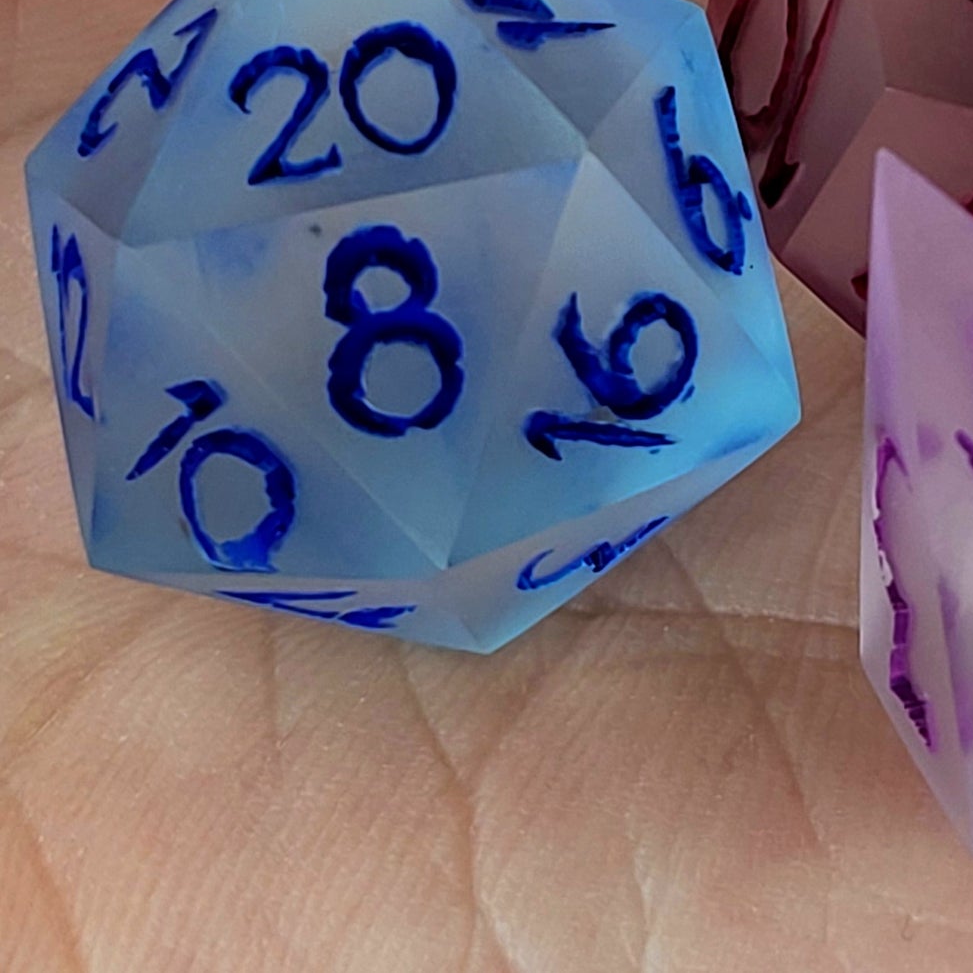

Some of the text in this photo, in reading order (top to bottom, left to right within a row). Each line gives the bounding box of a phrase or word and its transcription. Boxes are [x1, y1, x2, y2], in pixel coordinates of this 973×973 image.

[229, 19, 458, 186] 20
[322, 224, 465, 437] 8
[521, 291, 699, 461] 16
[125, 377, 296, 575] 10
